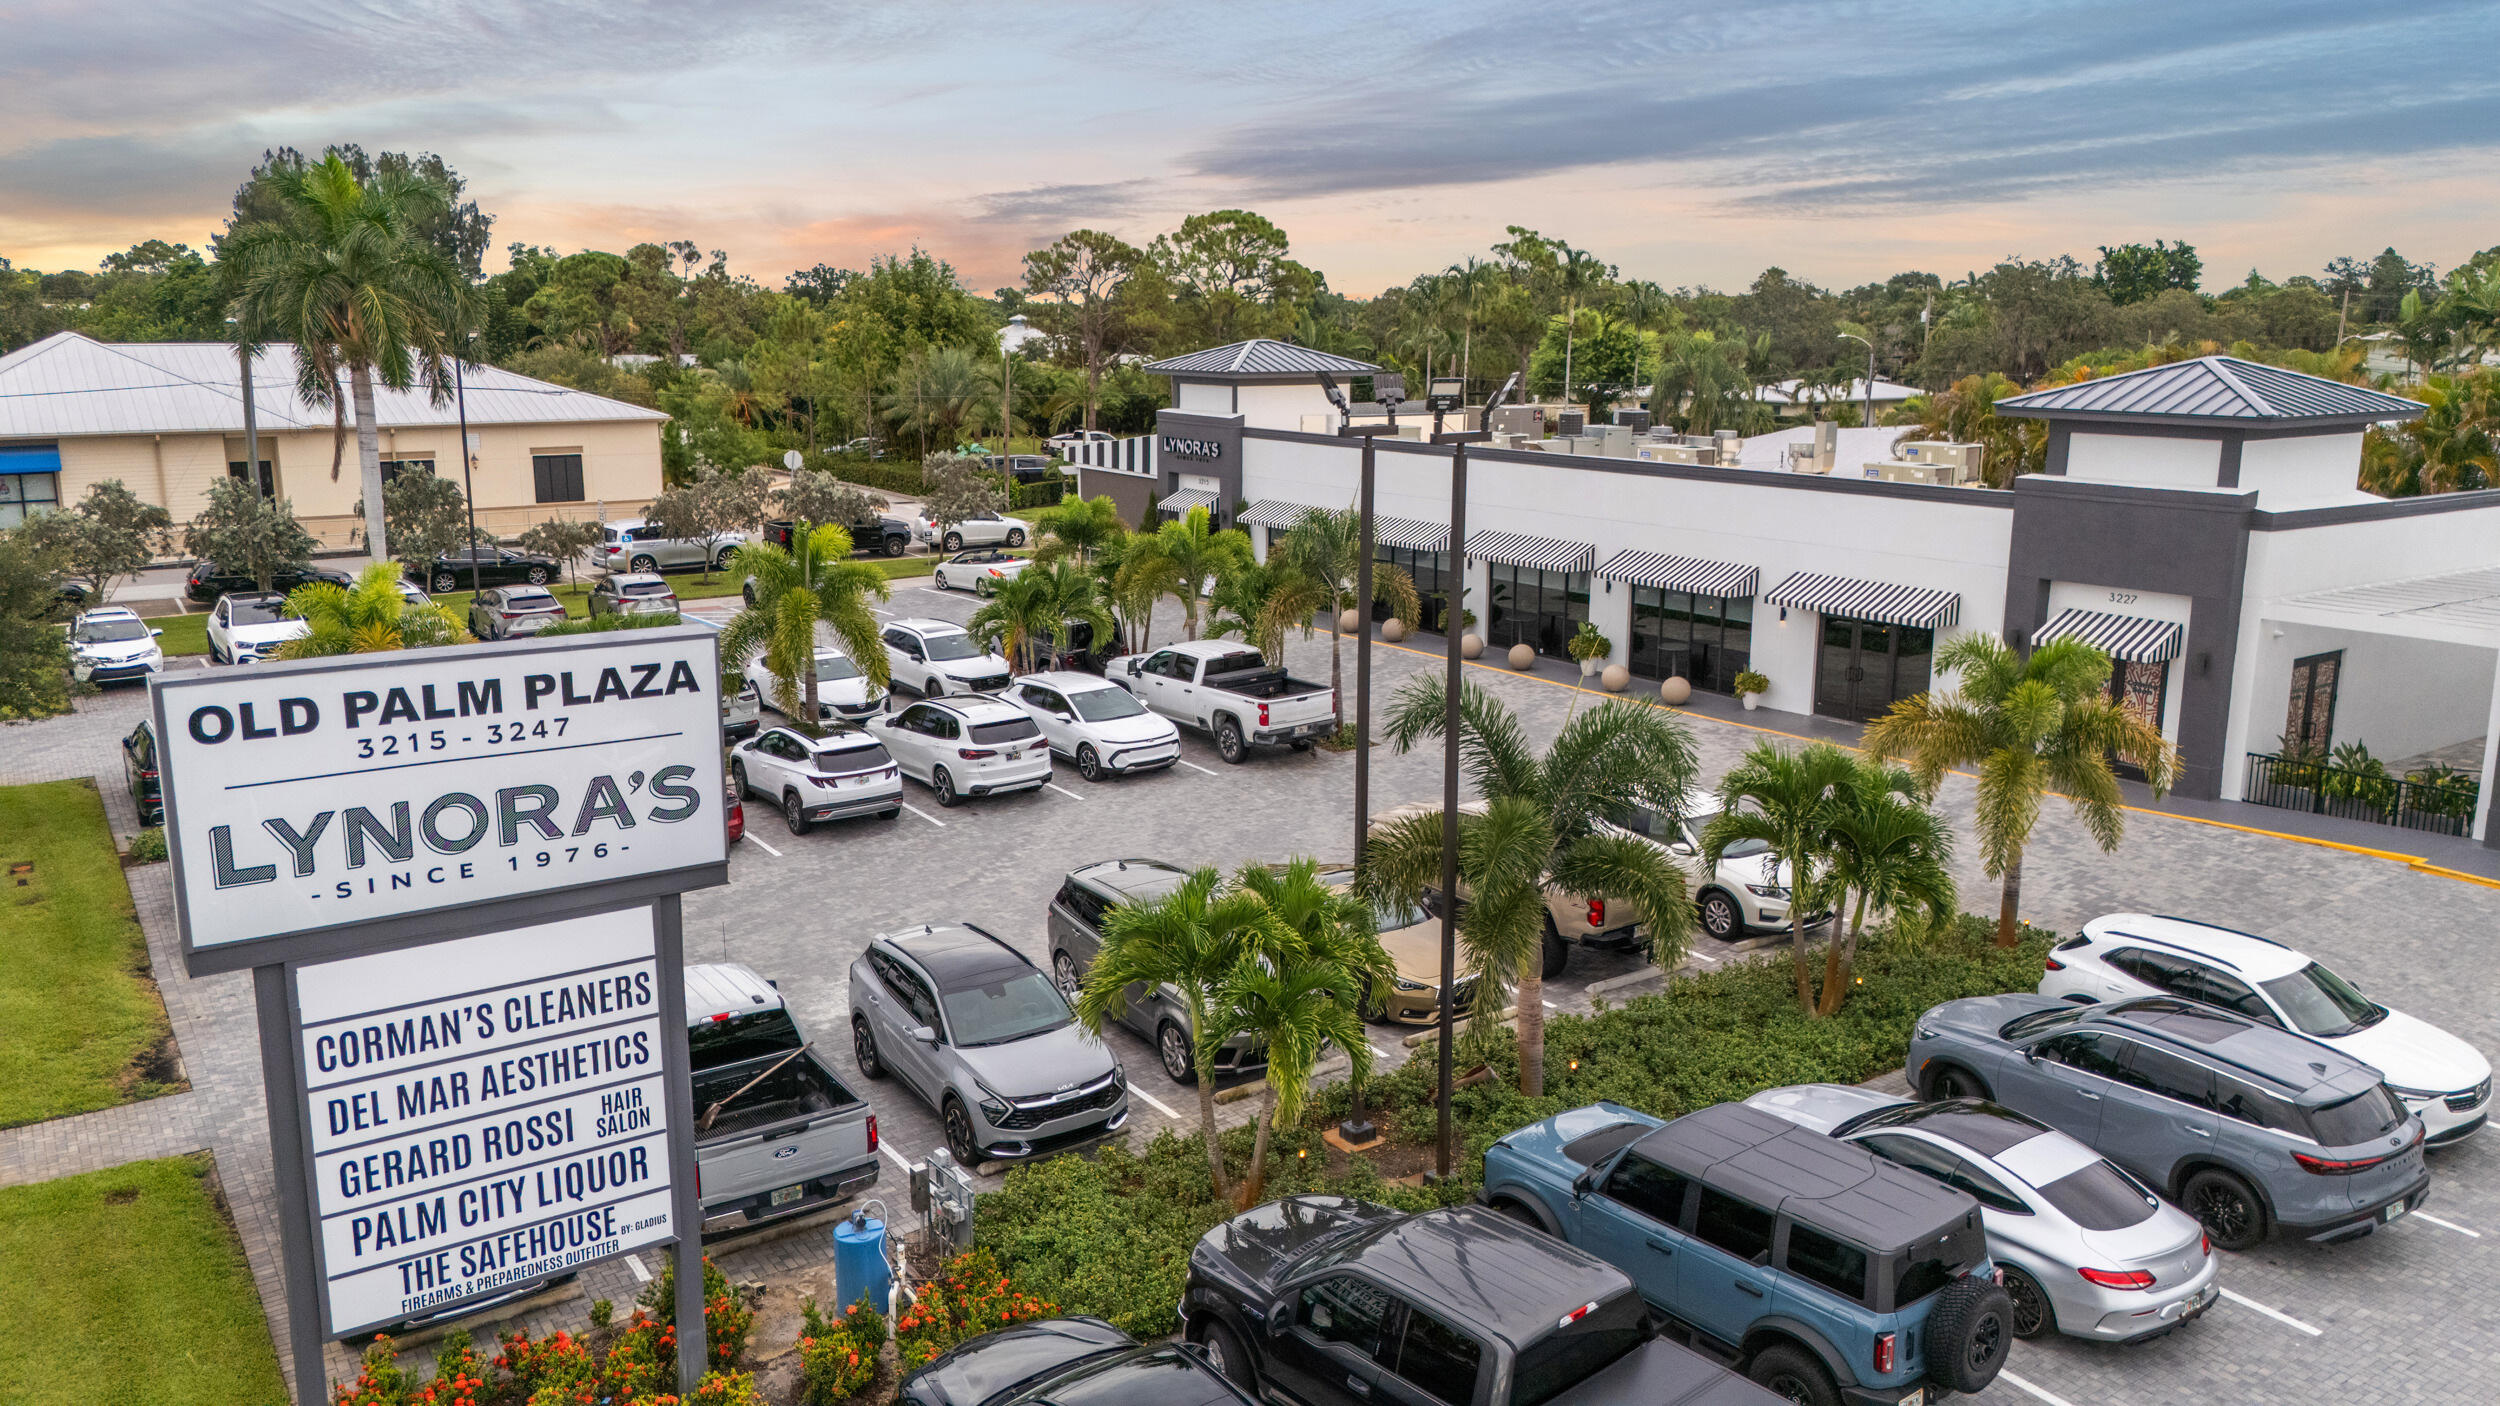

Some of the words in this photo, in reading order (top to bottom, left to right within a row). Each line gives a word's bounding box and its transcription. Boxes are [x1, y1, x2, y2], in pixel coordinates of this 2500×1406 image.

[1163, 438, 1219, 457] LYNORA'S
[2109, 592, 2138, 604] 3227
[188, 697, 320, 745] OLD
[343, 678, 503, 729] PALM
[524, 660, 701, 710] PLAZA
[357, 731, 447, 759] 3215
[487, 717, 569, 745] 3247
[208, 764, 701, 890] LYNORA'S
[316, 1003, 495, 1073] CORMAN'S
[504, 971, 651, 1033] CLEANERS
[327, 1090, 389, 1137] DEL
[396, 1071, 471, 1121] MAR
[481, 1031, 650, 1102] AESTHETICS
[596, 1106, 651, 1138] SALON
[601, 1087, 643, 1116] HAIR
[339, 1133, 472, 1198] GERARD
[482, 1107, 574, 1163] ROSSI
[351, 1196, 447, 1257] PALM
[458, 1175, 526, 1228] CITY
[536, 1145, 649, 1208] LIQUOR
[620, 1223, 635, 1235] BY:
[635, 1213, 667, 1232] GLADIUS
[397, 1251, 452, 1296] THE
[460, 1205, 617, 1278] SAFEHOUSE
[401, 1284, 463, 1314] FIREARMS
[465, 1281, 474, 1295] &
[476, 1255, 563, 1292] PREPAREDNESS
[565, 1239, 620, 1266] OUTFITTER
